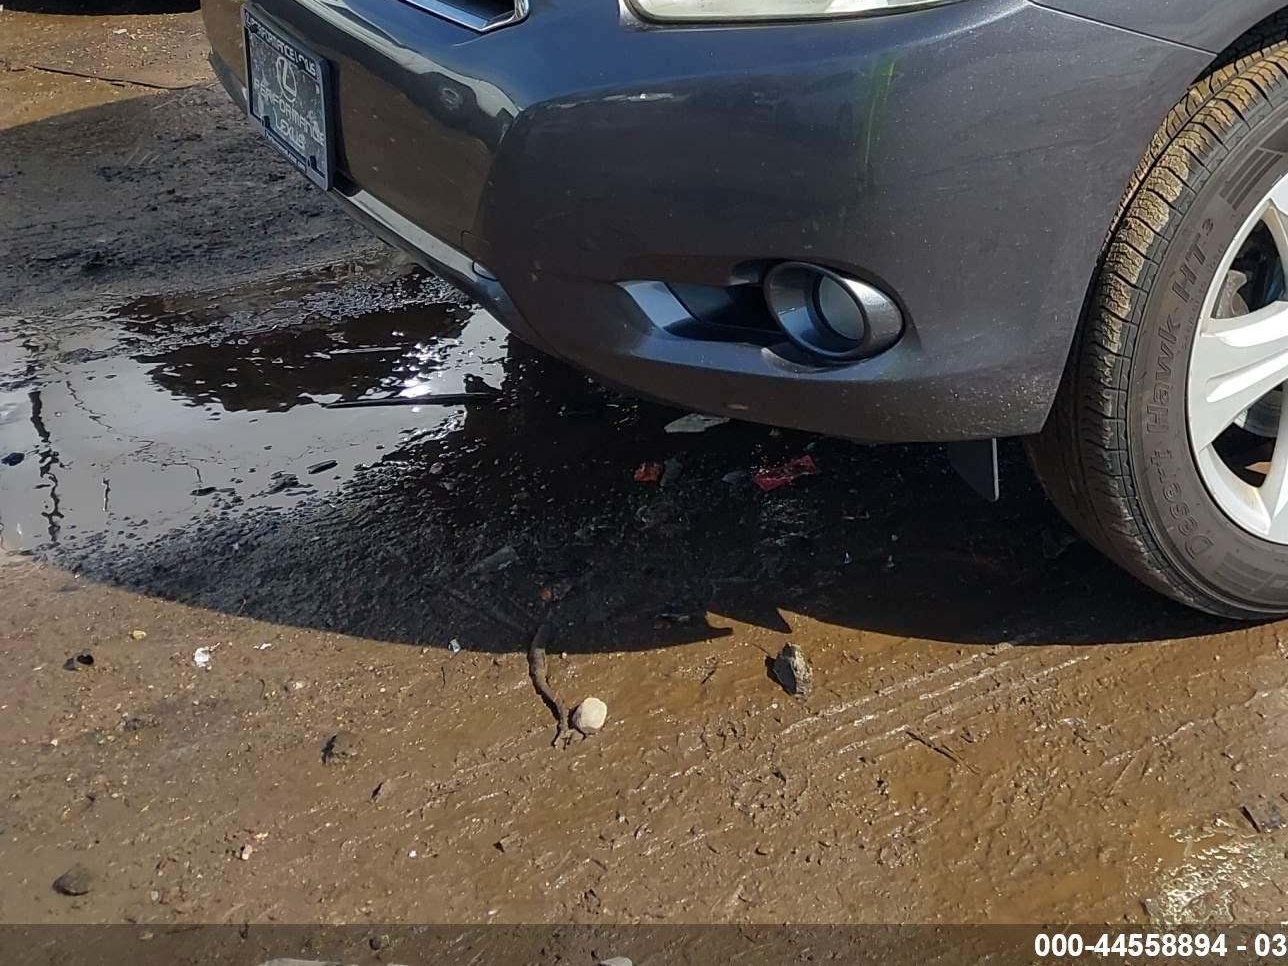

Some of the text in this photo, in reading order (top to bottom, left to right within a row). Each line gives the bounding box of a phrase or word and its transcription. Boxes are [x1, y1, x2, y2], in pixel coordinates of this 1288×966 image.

[253, 77, 326, 147] PERFORMANCE
[272, 106, 306, 150] LEXUS
[1146, 313, 1182, 434] Hawk
[1150, 447, 1215, 561] Desert
